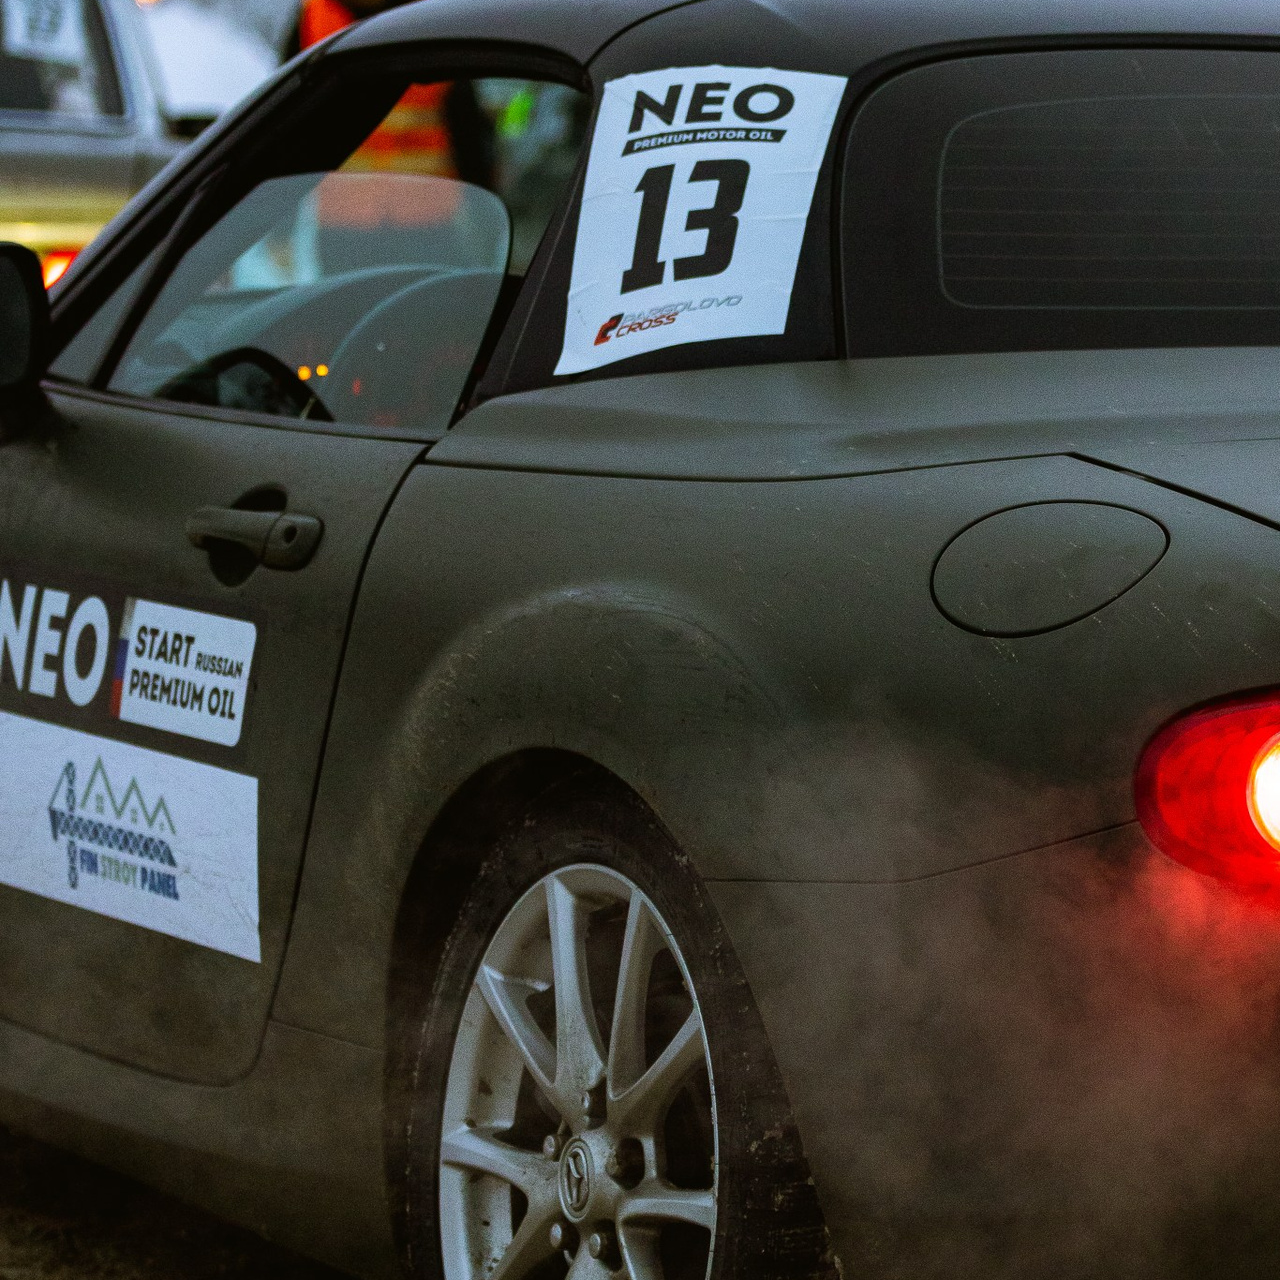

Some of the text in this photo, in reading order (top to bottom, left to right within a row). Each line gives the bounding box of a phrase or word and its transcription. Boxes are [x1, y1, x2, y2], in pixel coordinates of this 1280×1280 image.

[628, 82, 795, 134] NEO
[633, 128, 774, 151] PREMIUM MOTOR OIL
[620, 159, 750, 295] 13
[615, 311, 679, 338] CROSS
[0, 578, 110, 707] NEO
[135, 625, 244, 679] START RUSSIAN
[129, 668, 236, 720] PREMIUM OIL
